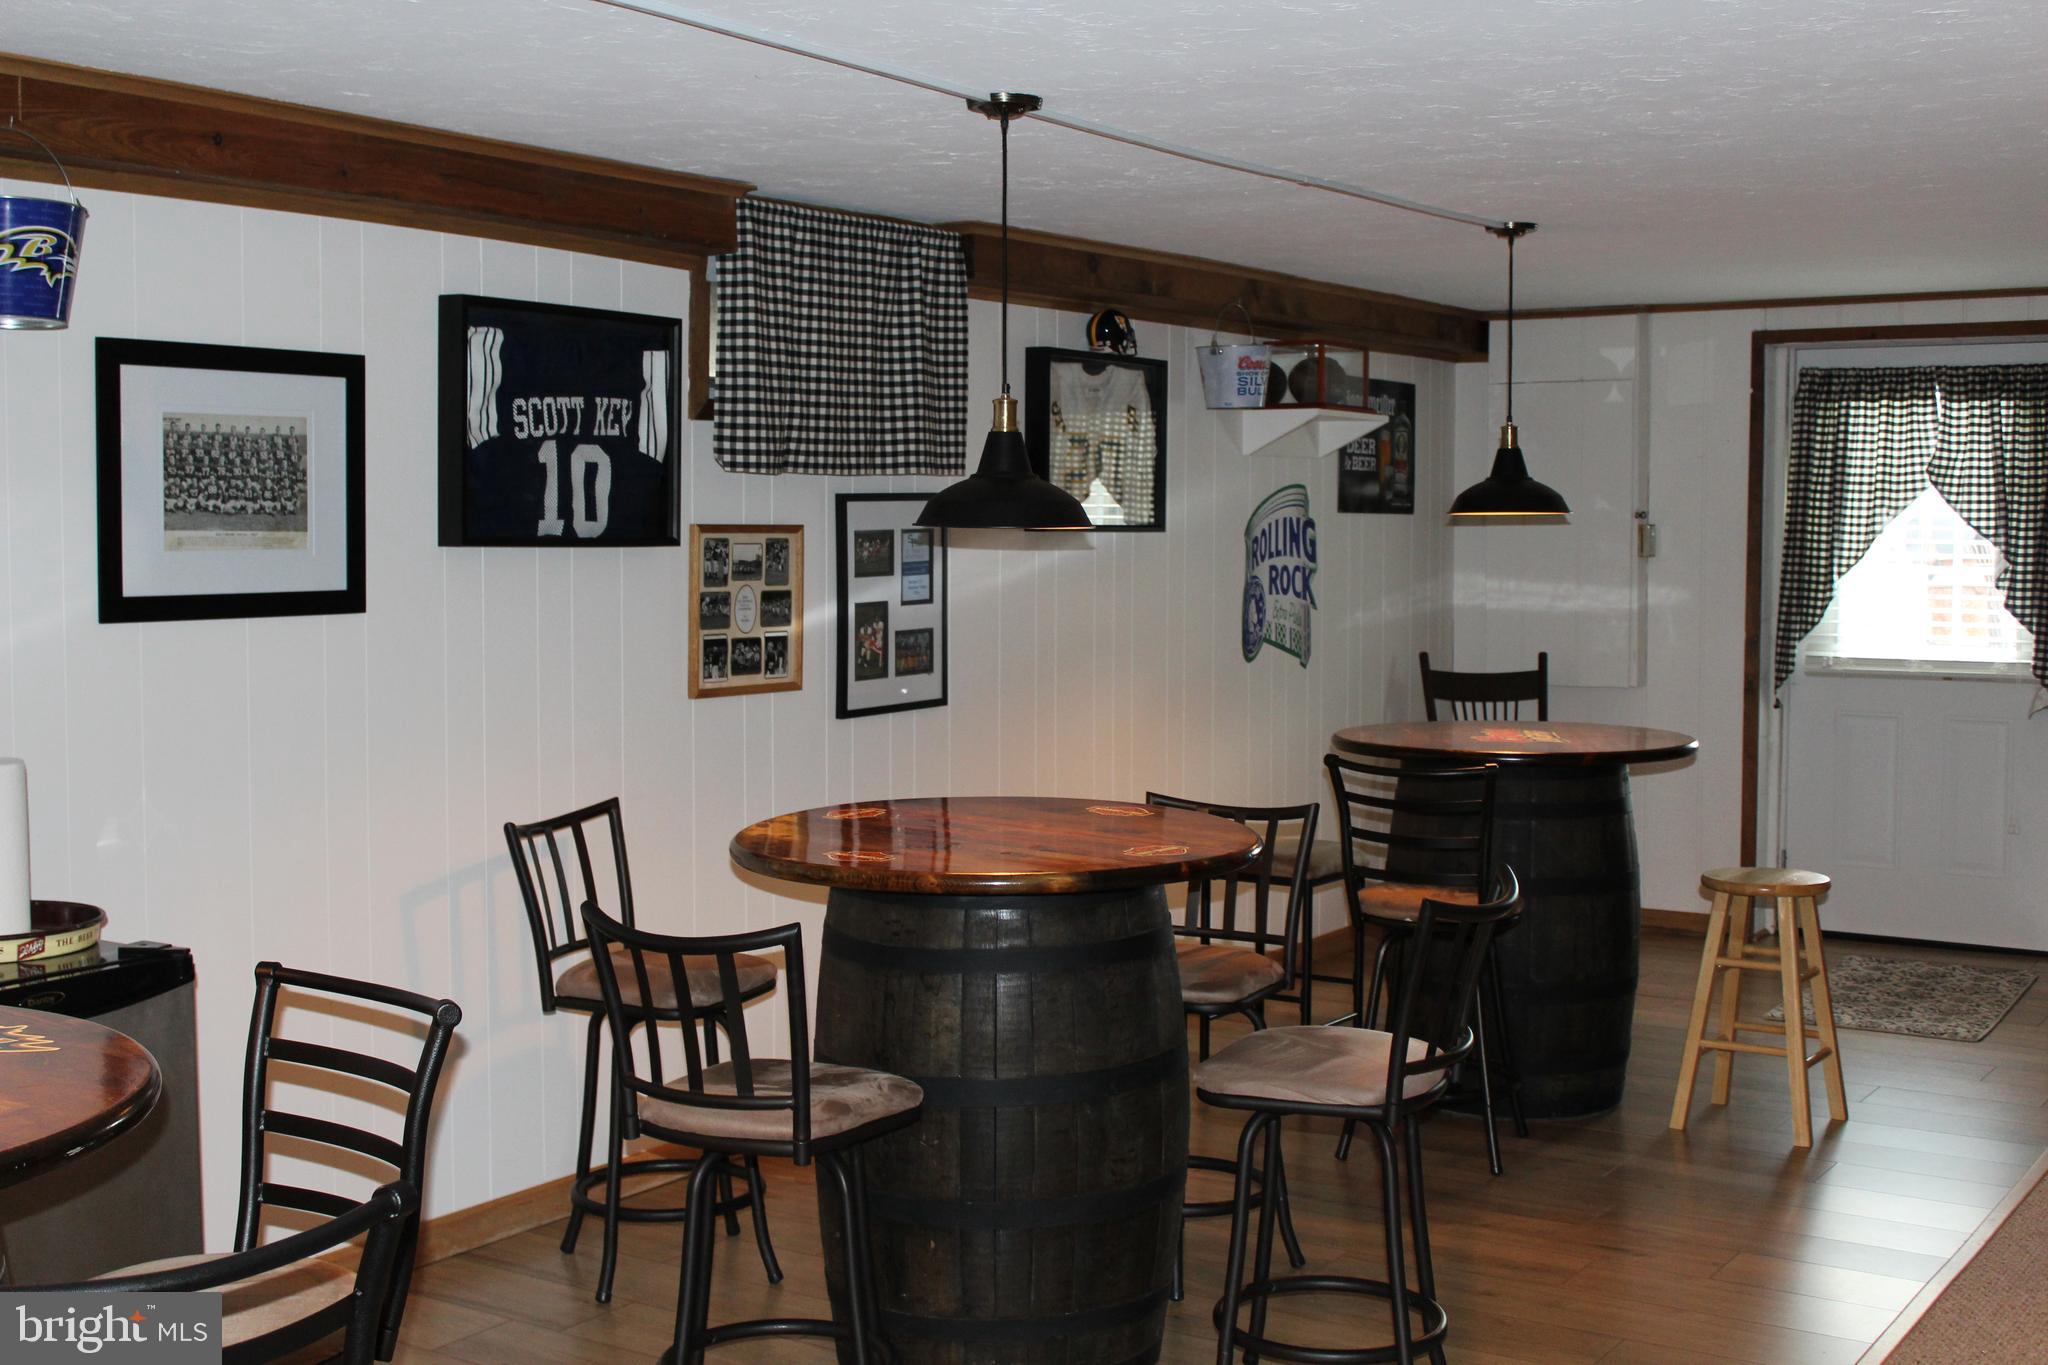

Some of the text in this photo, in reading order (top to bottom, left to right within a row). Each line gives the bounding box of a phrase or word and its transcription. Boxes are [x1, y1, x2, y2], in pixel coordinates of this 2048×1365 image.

[512, 396, 632, 439] SCOTT KEY
[537, 439, 611, 538] 10
[1252, 516, 1317, 570] ROLLING
[1269, 564, 1313, 606] ROCK
[56, 937, 74, 948] THE
